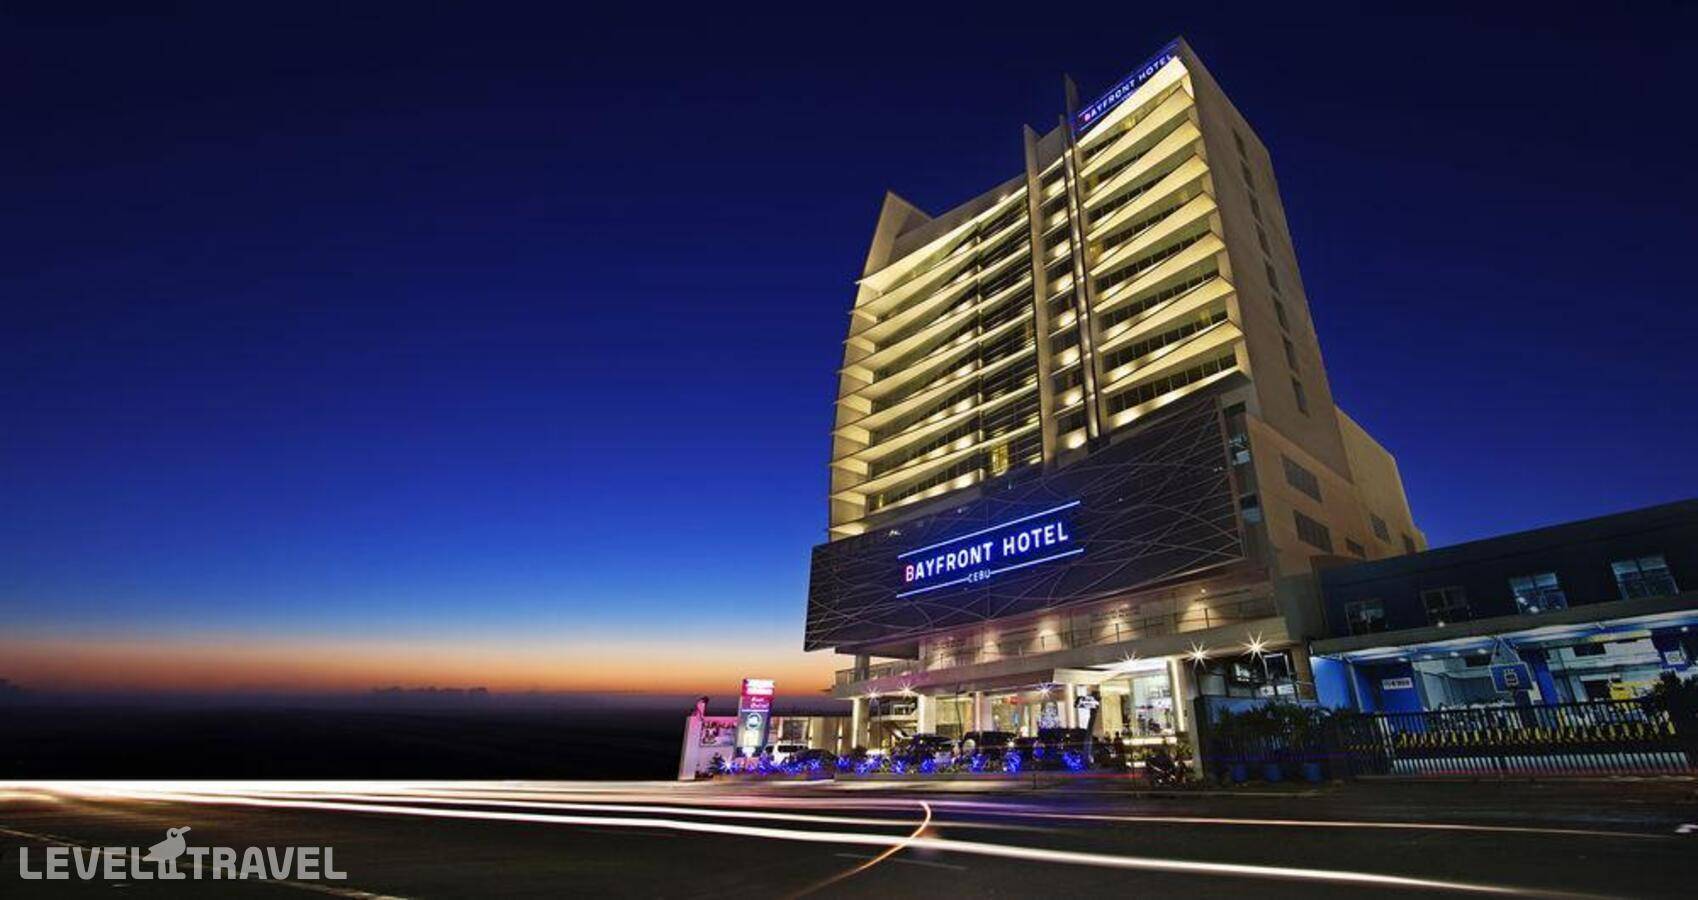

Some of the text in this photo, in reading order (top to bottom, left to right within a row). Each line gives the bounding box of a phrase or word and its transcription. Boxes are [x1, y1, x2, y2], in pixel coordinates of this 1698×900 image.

[1084, 79, 1135, 122] BAYFRONT
[905, 522, 1069, 582] BAYFRONT HOTEL
[968, 569, 991, 583] CEBU
